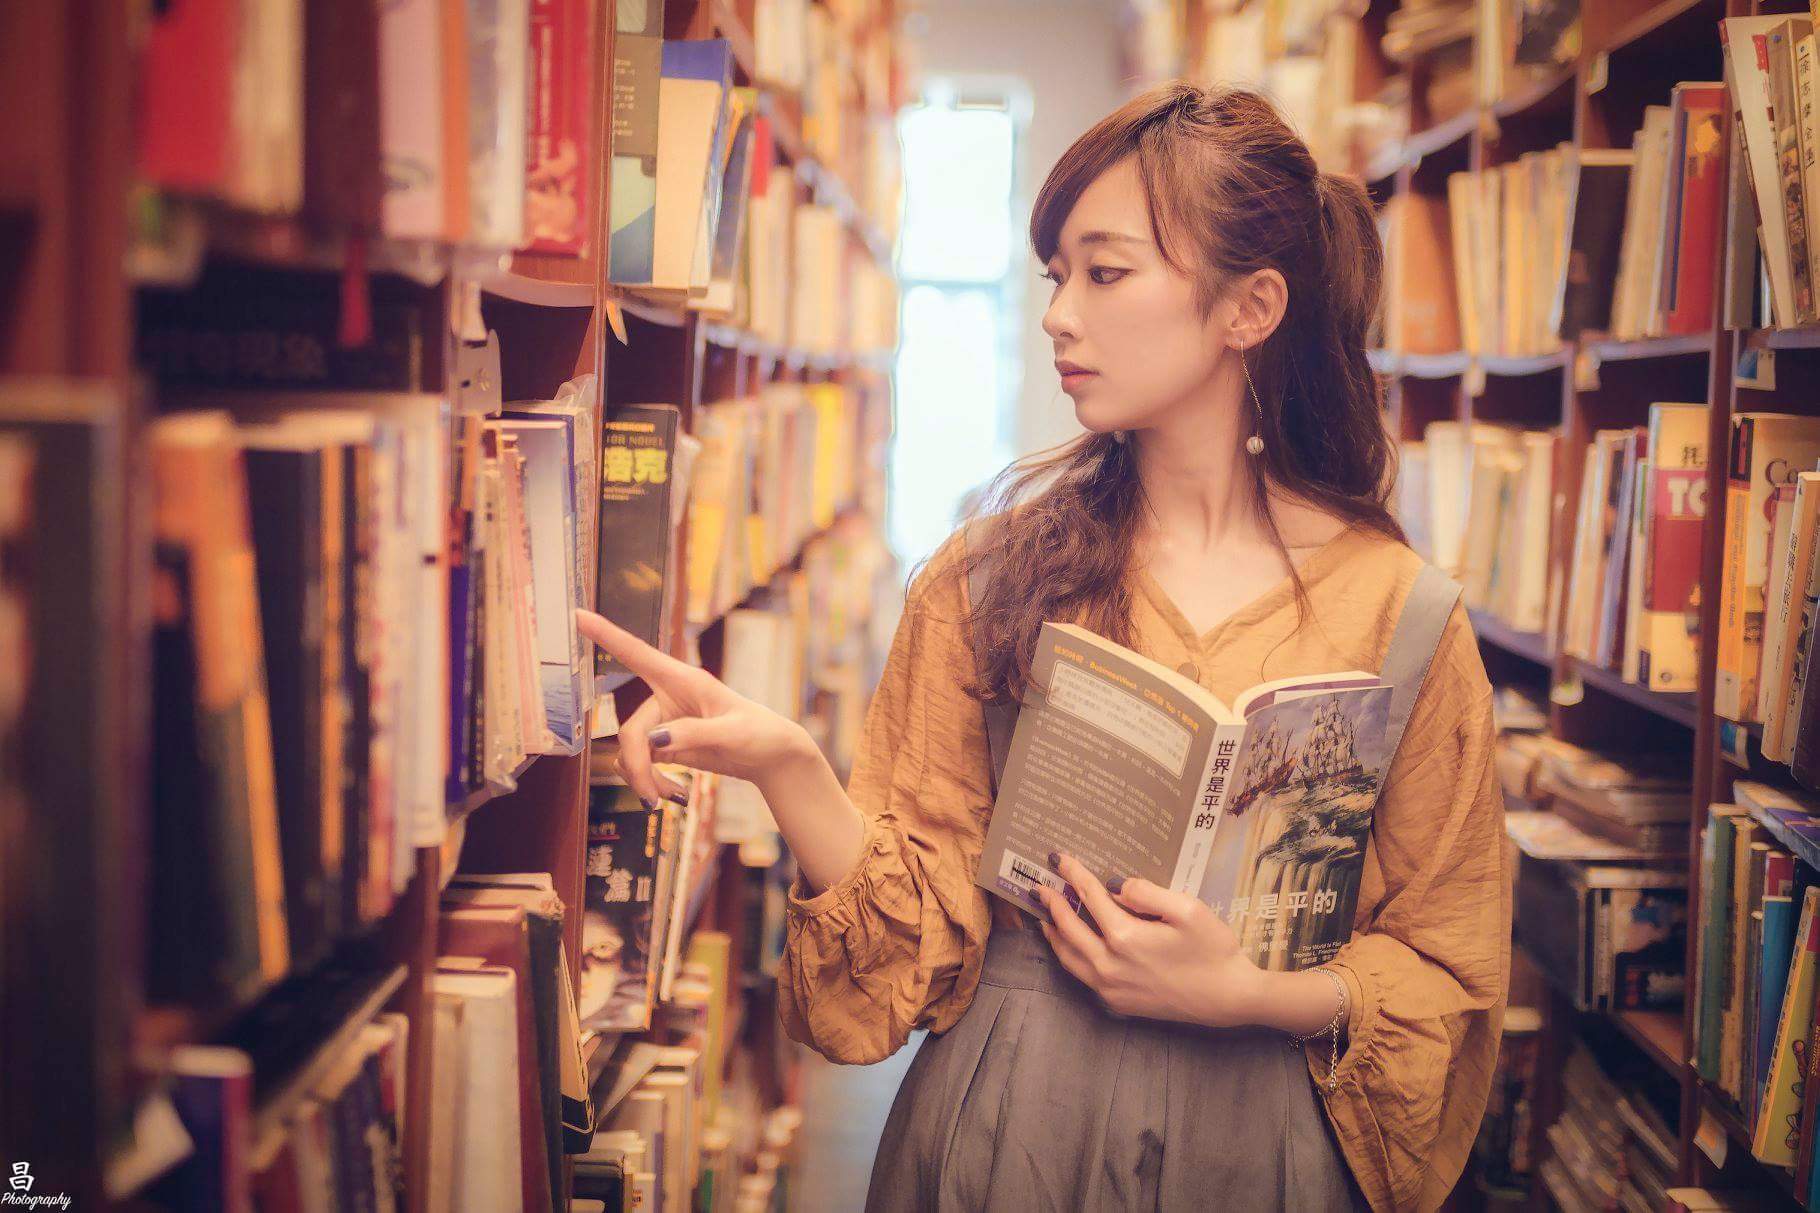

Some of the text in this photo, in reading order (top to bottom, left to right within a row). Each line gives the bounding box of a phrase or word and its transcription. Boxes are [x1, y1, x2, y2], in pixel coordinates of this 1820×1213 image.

[1194, 739, 1236, 830] 世界是平的
